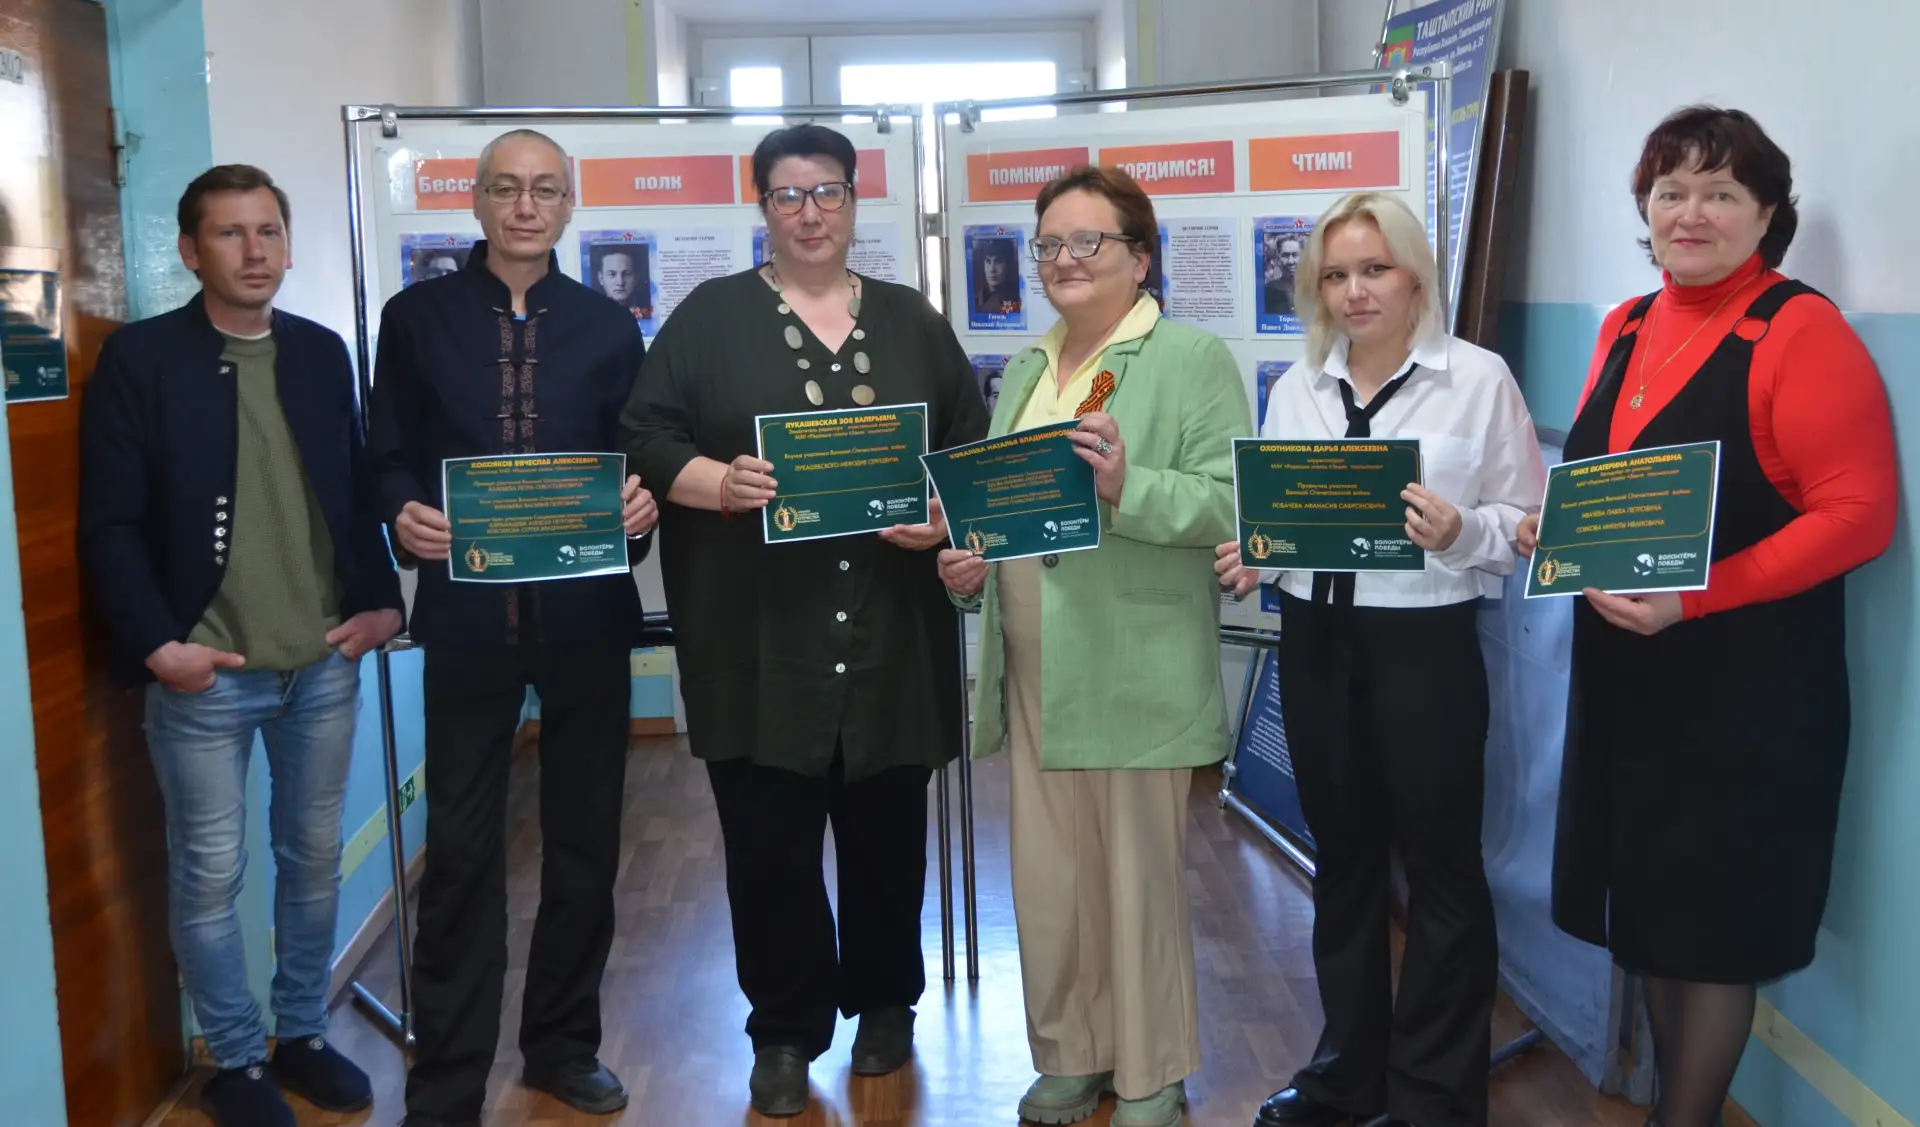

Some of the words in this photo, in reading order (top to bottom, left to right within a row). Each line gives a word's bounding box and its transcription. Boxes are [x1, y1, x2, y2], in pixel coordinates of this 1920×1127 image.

[1291, 151, 1352, 173] ЧТИМ!
[634, 174, 683, 191] полк
[785, 419, 838, 429] ЛУКАШЕВСКАЯ
[855, 414, 896, 423] ВАЛЕРЬЕВНА
[949, 447, 986, 460] КОВАЛЕВА
[988, 439, 1018, 450] НАТАЛЬЯ
[1590, 461, 1627, 473] ЕКАТЕРИНА
[1629, 454, 1682, 466] АНАТОЛЬЕВНА
[887, 497, 918, 505] ВОЛОНТЁРЫ
[1658, 552, 1697, 560] ВОЛОНТЁРЫ
